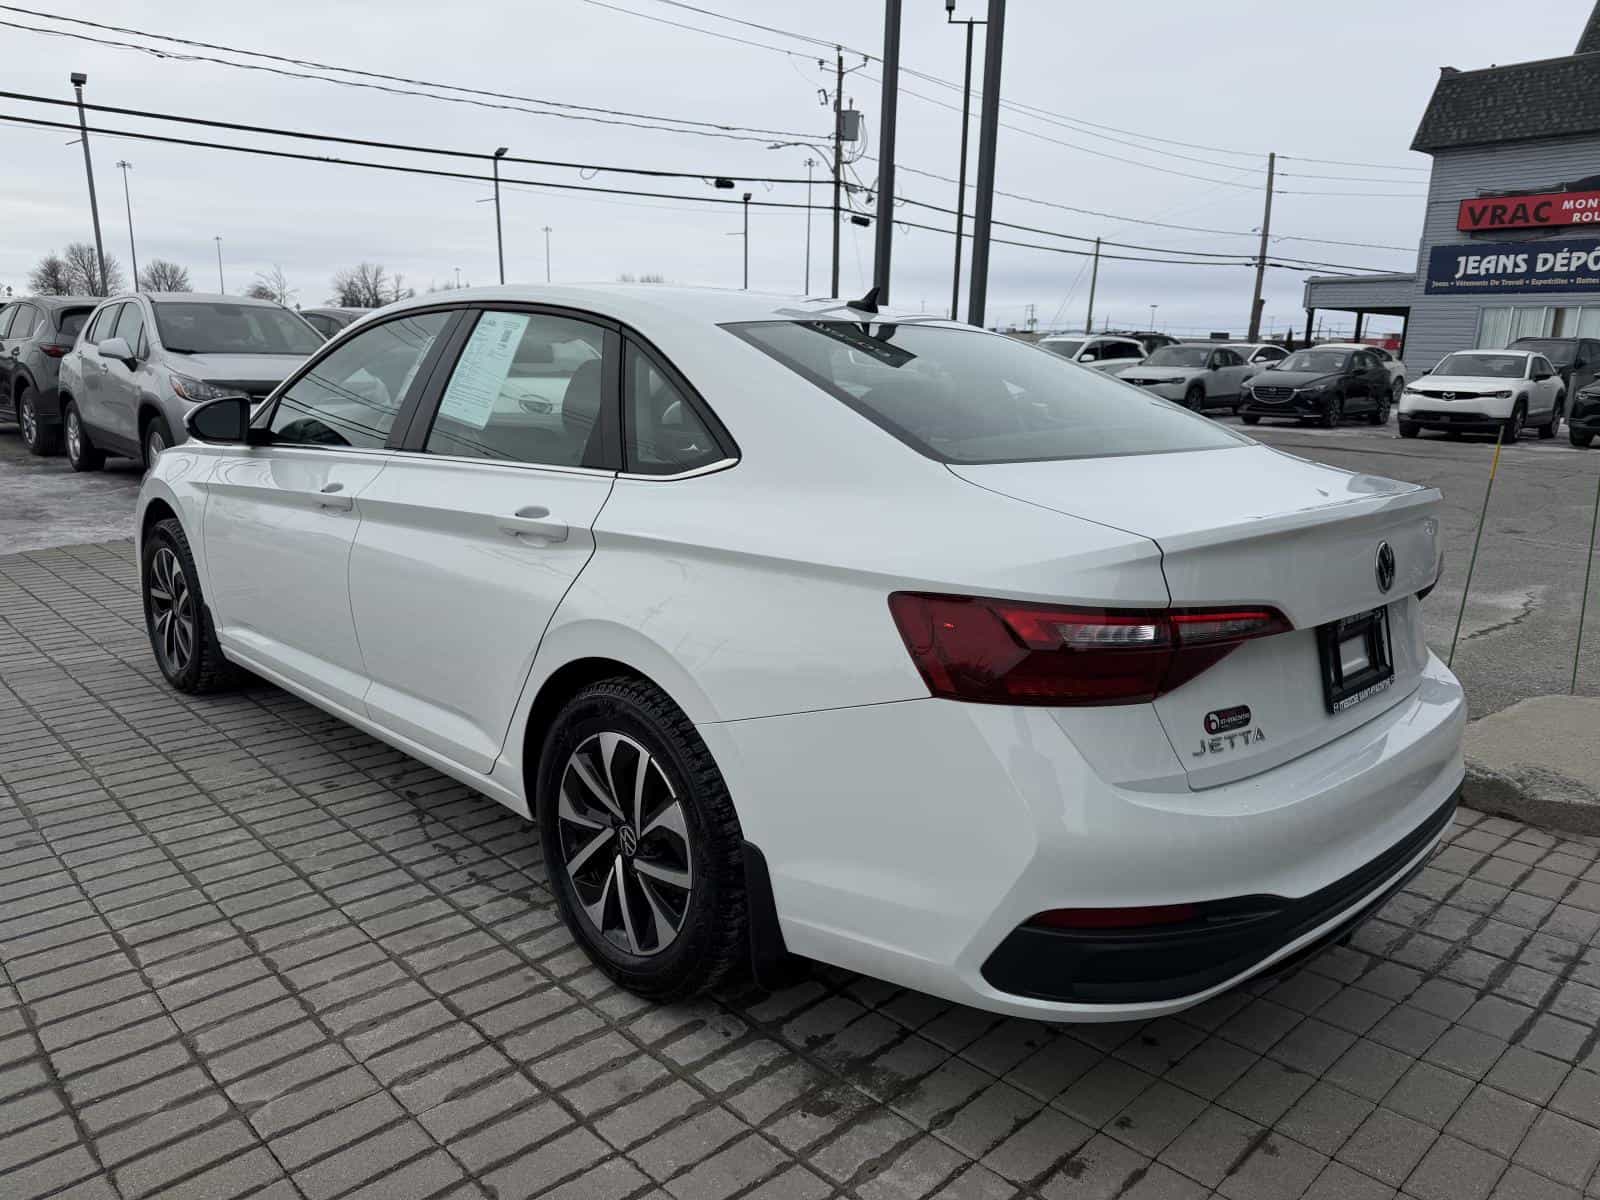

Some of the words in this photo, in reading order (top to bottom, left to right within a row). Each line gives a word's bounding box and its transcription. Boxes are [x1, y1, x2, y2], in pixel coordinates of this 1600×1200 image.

[1468, 201, 1553, 226] VRAC
[1562, 198, 1600, 210] MON
[1454, 253, 1529, 278] JEANS
[1192, 727, 1265, 757] JETTA
